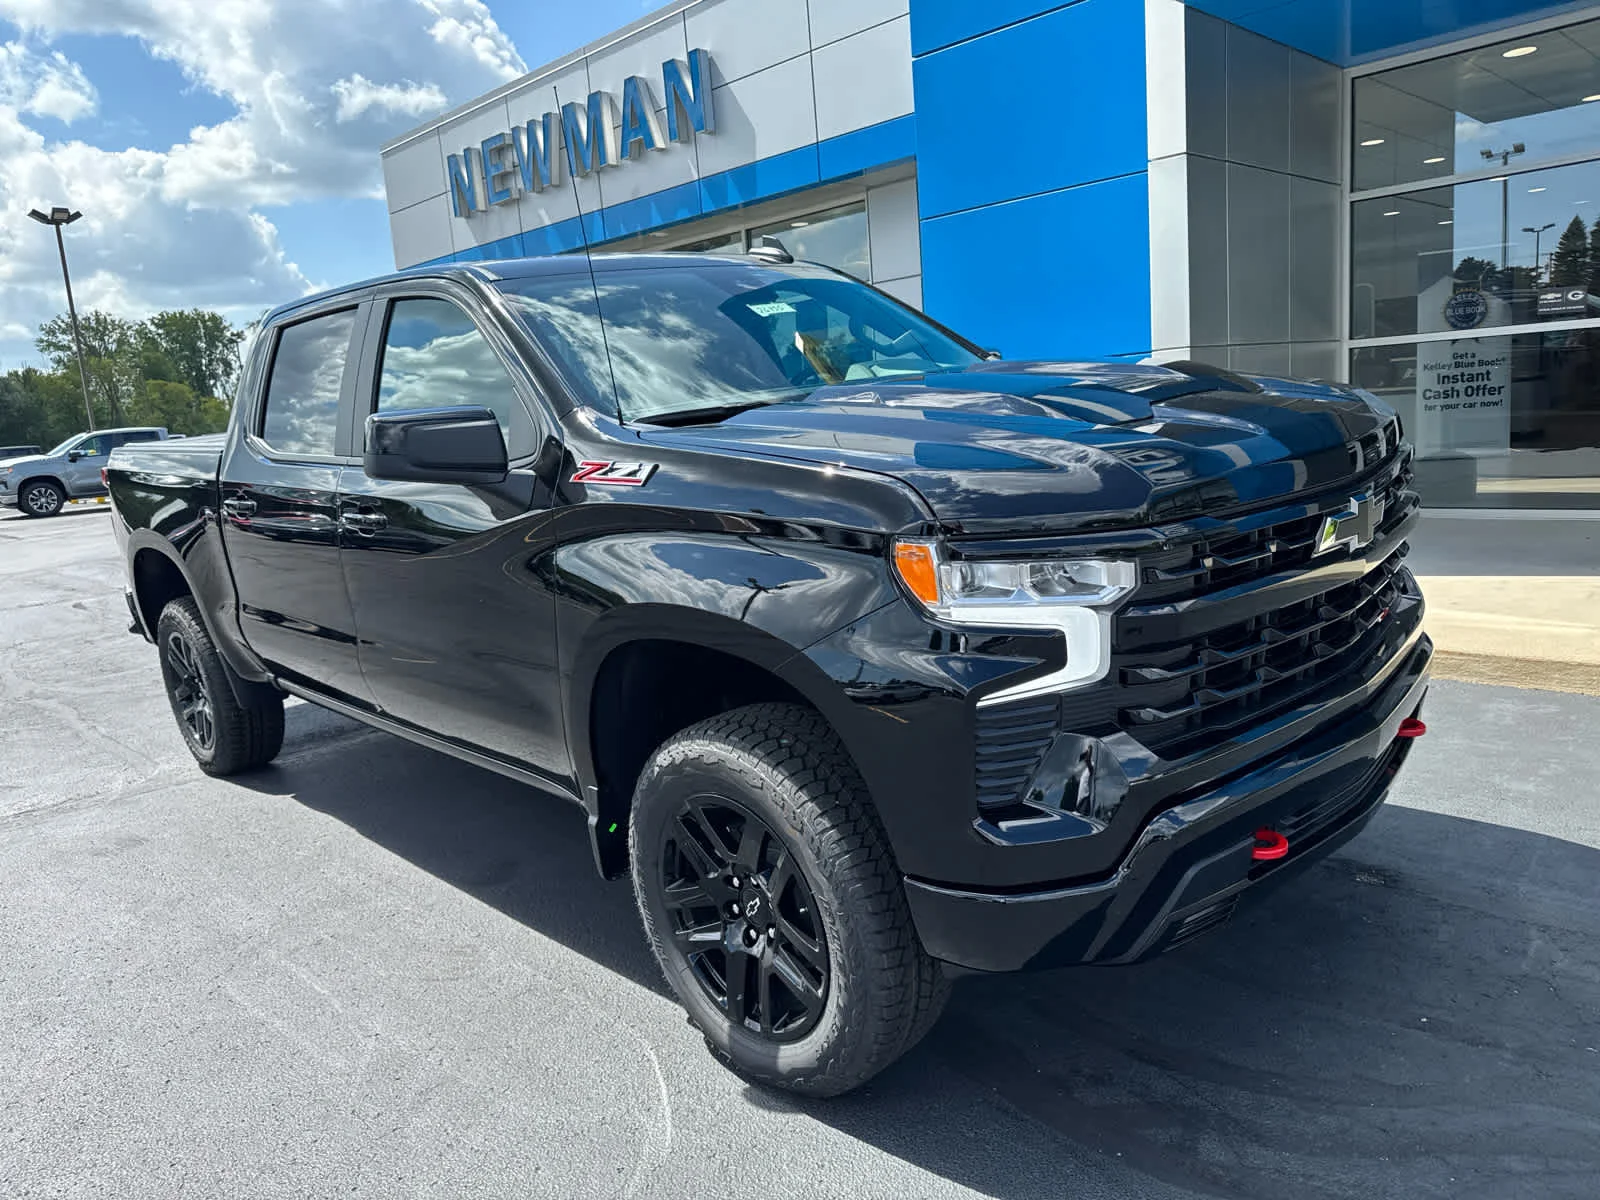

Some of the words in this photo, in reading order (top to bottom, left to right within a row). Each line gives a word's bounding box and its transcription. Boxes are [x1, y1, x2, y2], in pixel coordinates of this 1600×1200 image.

[447, 48, 716, 218] NEWMAN
[1452, 352, 1468, 360] Get
[1423, 362, 1452, 371] Kelley
[1454, 360, 1476, 369] Blue
[1437, 369, 1491, 385] Instant
[1422, 386, 1460, 400] Cash
[1464, 383, 1505, 397] Offer
[1424, 403, 1438, 412] for
[1440, 402, 1460, 412] your
[1462, 401, 1478, 409] car
[1480, 399, 1503, 408] now!
[569, 460, 660, 487] Z71
